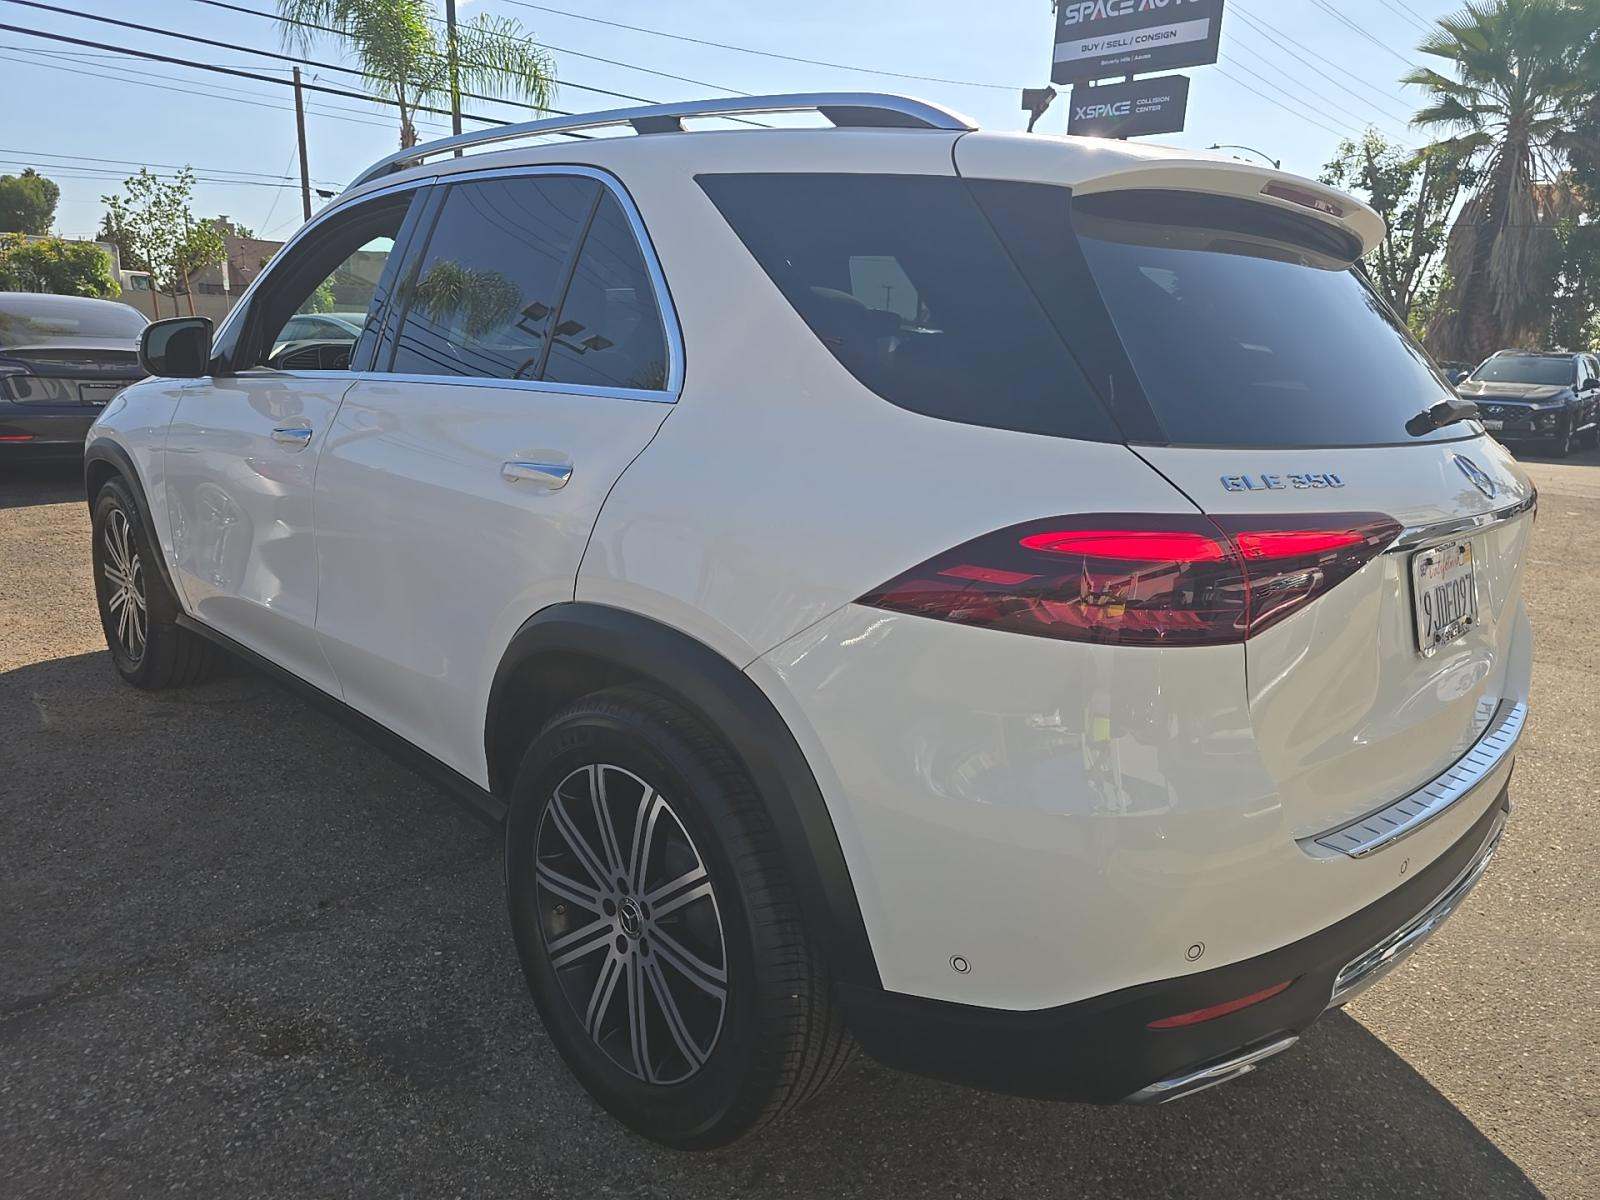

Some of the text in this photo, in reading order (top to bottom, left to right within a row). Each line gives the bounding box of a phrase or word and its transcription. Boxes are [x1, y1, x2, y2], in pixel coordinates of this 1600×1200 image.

[1064, 0, 1135, 26] SPACE
[1081, 42, 1100, 52] BUY
[1106, 39, 1128, 50] SELL
[1135, 30, 1177, 44] CONSIGN
[1135, 105, 1162, 113] CENTER
[1136, 96, 1170, 105] COLLISION
[1075, 101, 1131, 121] XSPACE
[1220, 473, 1346, 492] GLE 350
